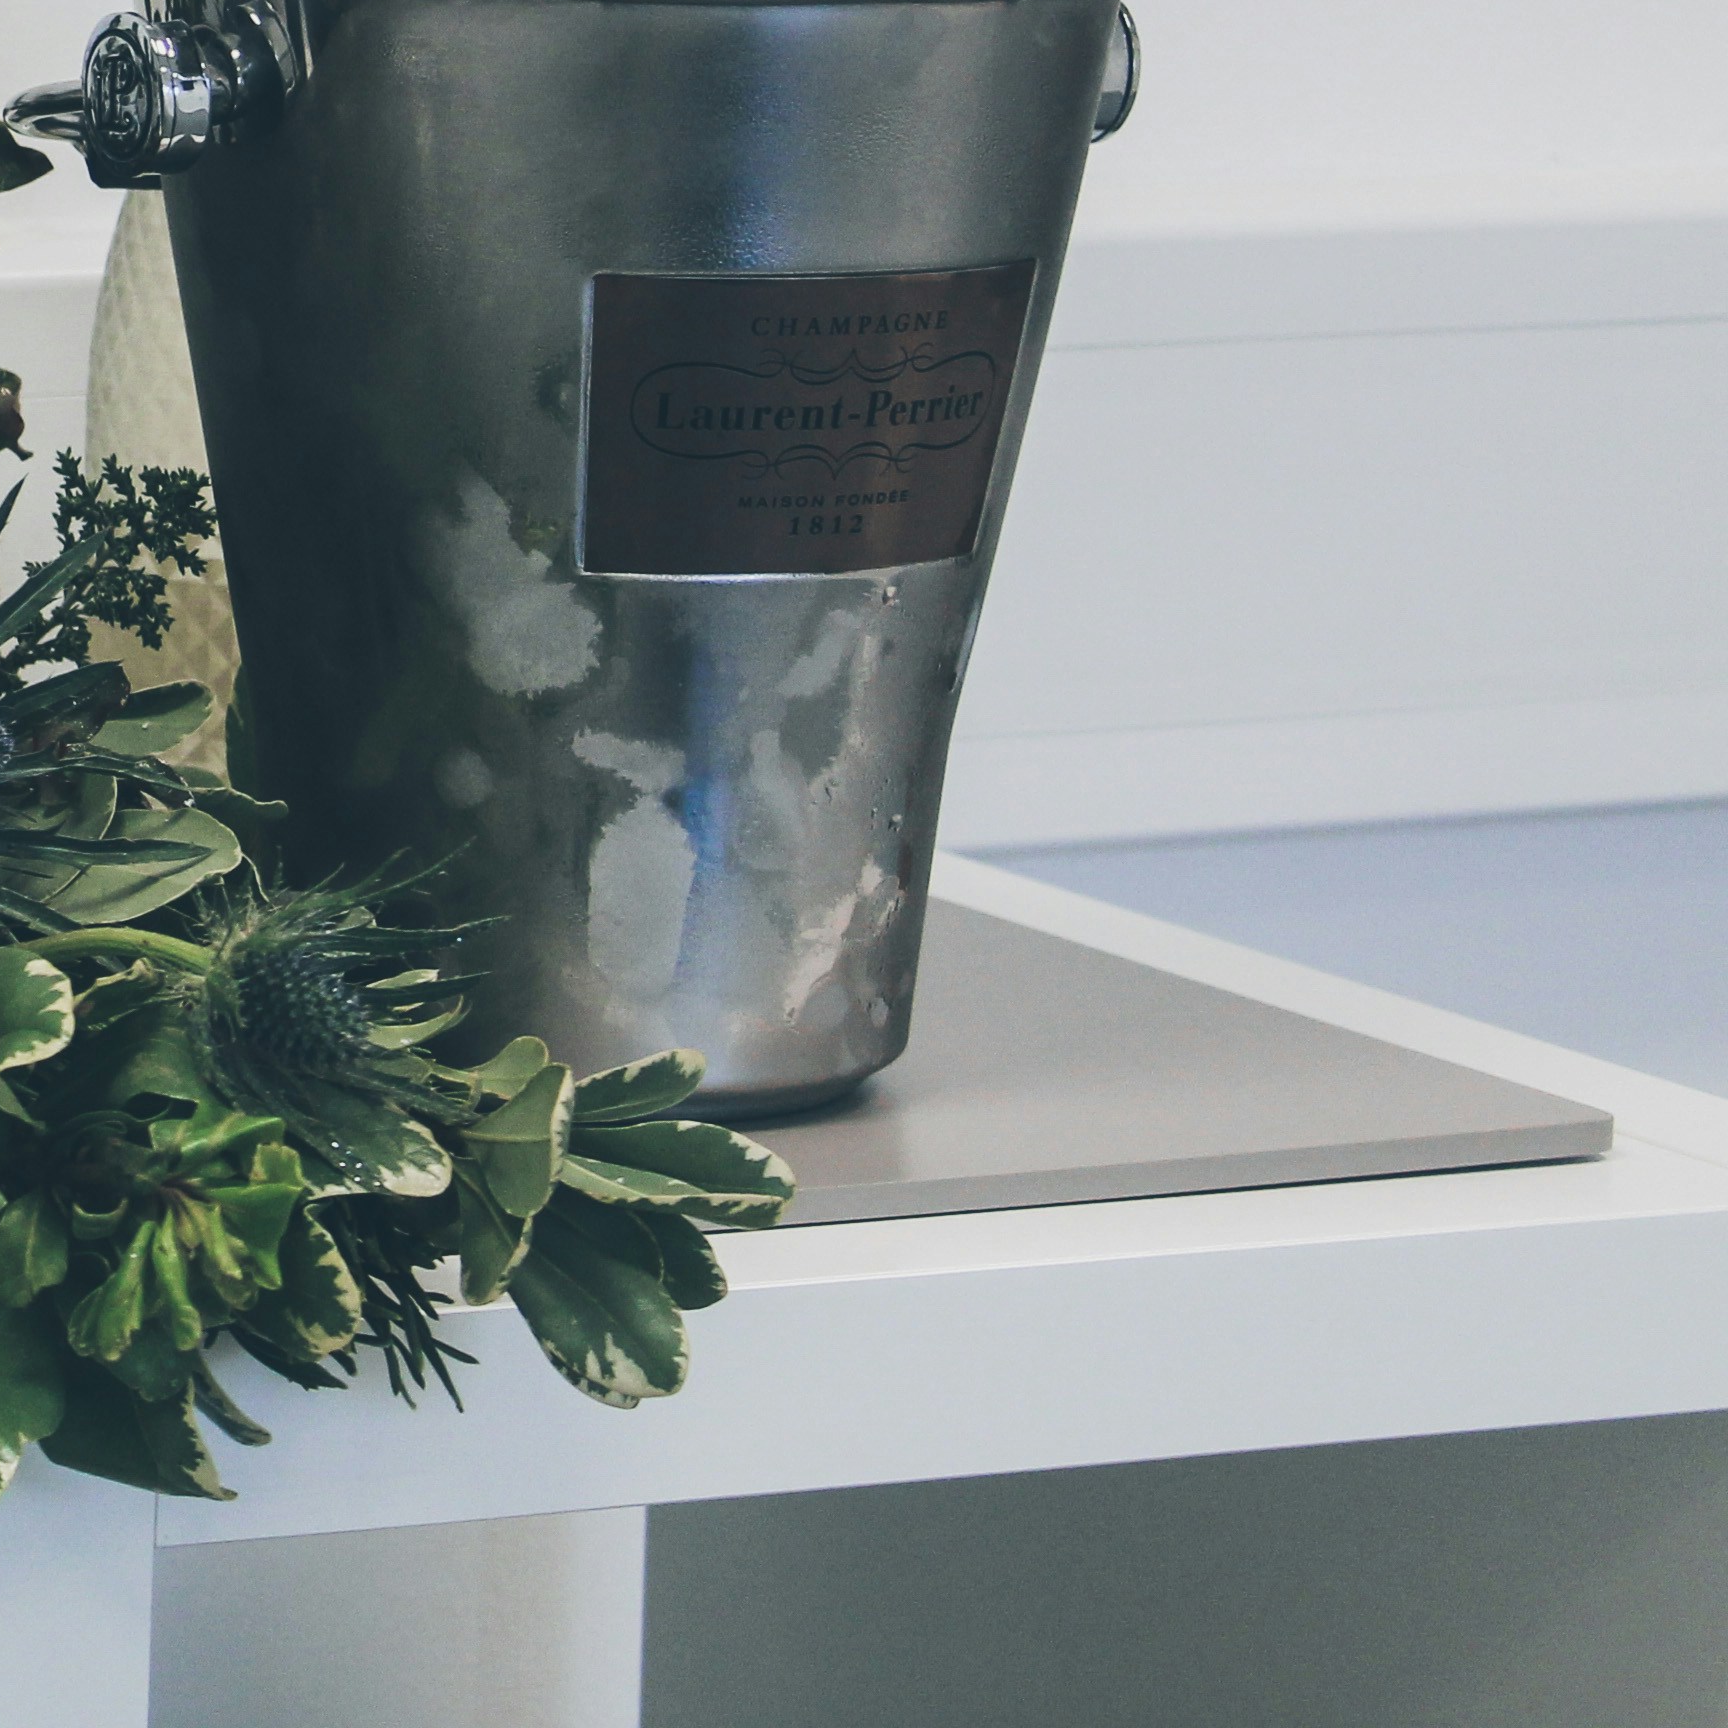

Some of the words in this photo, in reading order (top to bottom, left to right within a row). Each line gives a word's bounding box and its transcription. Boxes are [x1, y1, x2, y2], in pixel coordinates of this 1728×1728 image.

[750, 310, 950, 338] CHAMPAGNE
[655, 383, 984, 432] Laurent-Perrier
[737, 494, 825, 510] MAISON
[835, 489, 910, 507] FONDÉE
[787, 514, 865, 536] 1812
